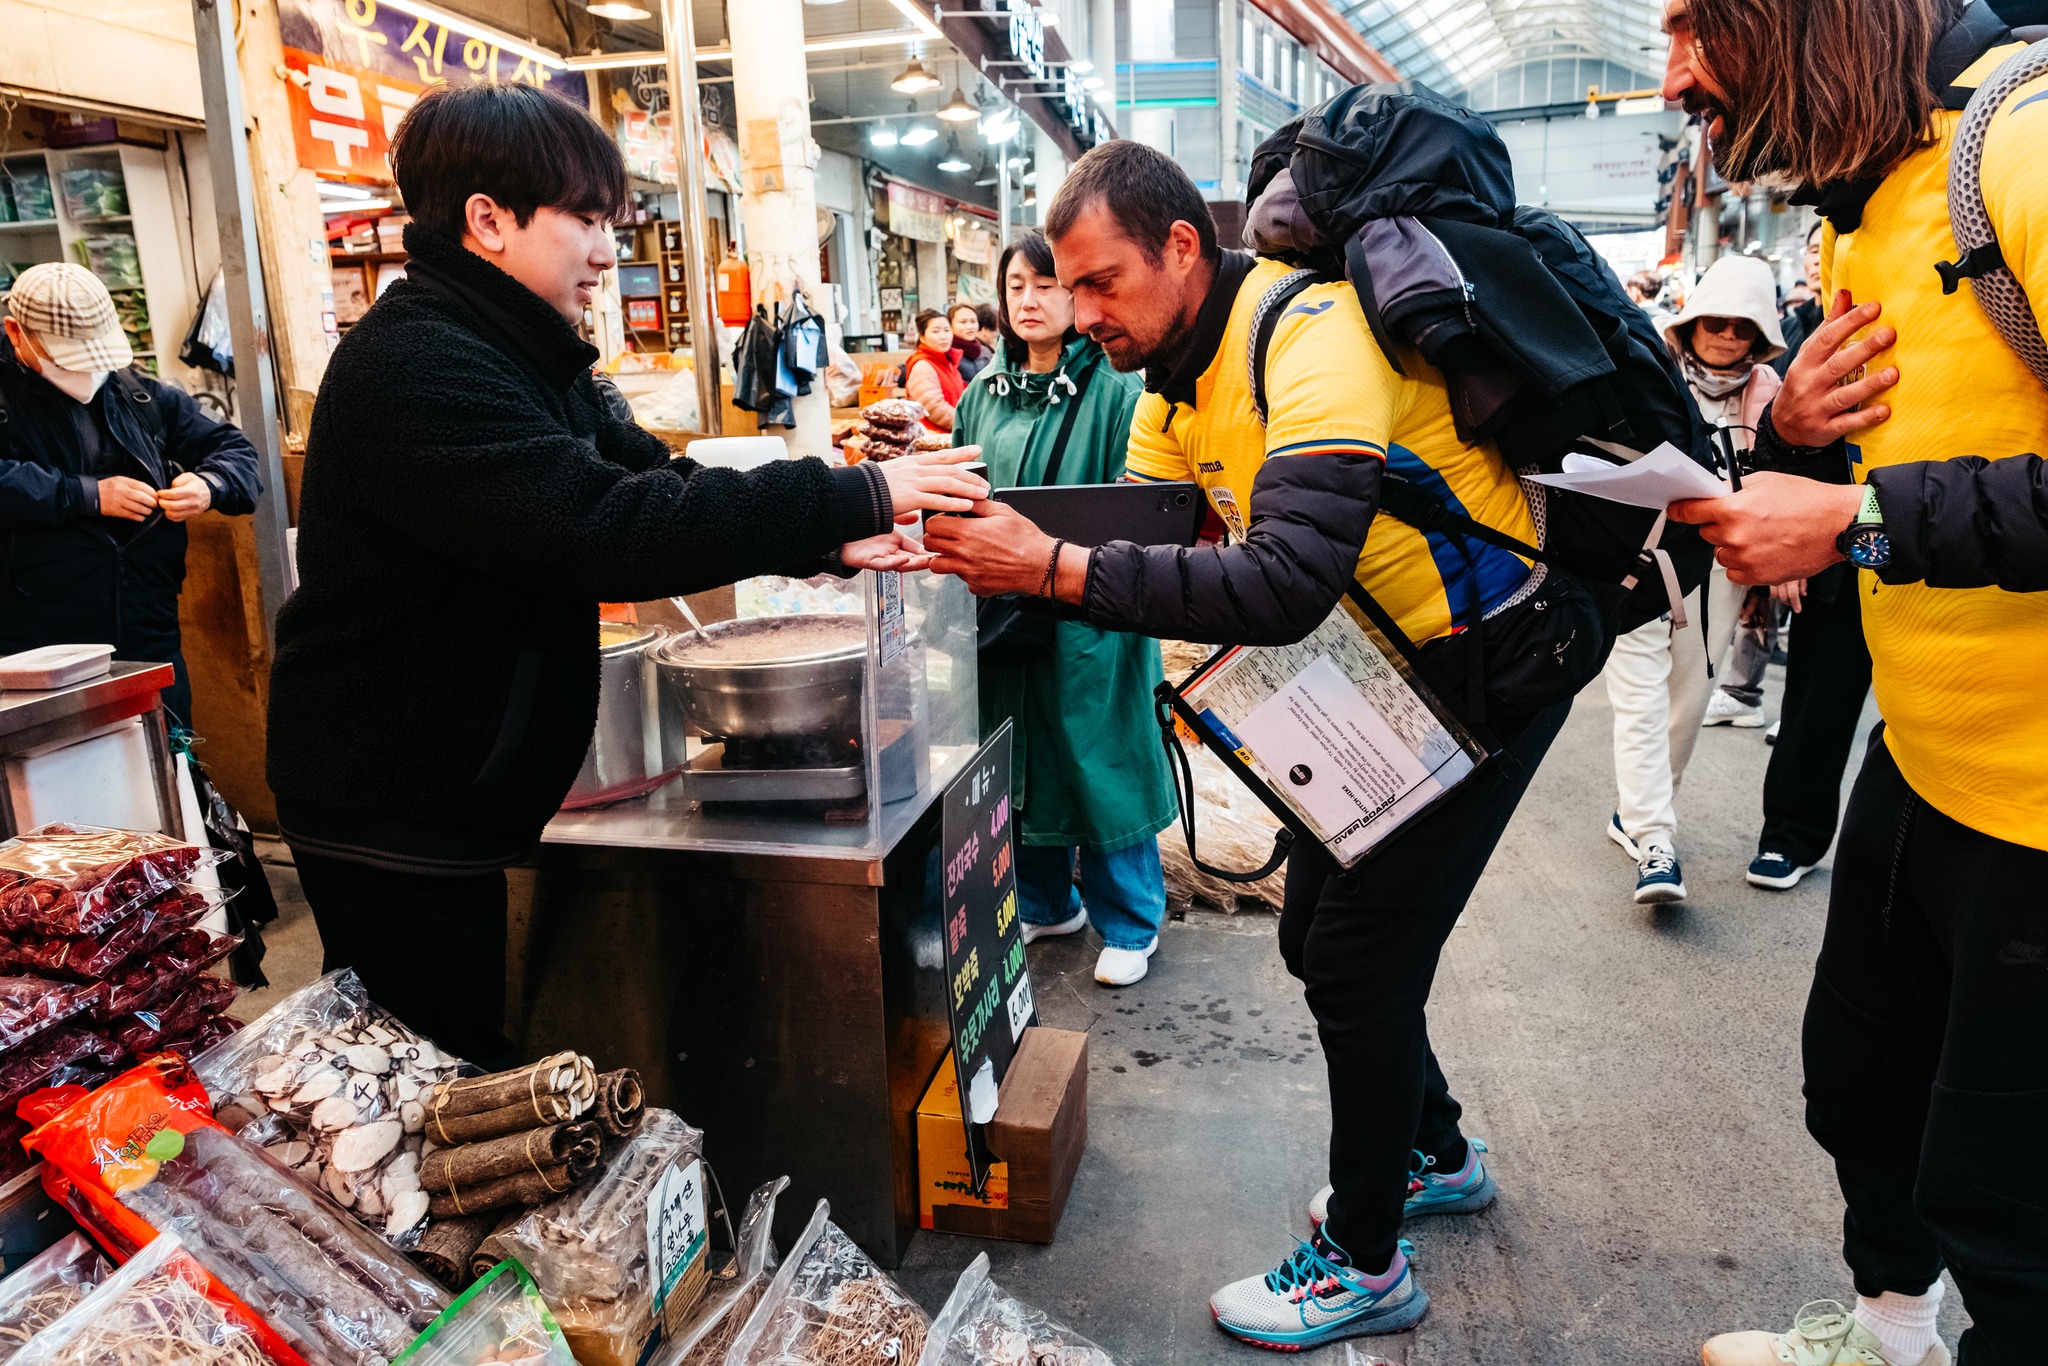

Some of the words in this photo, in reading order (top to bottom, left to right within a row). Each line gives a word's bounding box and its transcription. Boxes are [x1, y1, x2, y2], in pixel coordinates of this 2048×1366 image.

[1297, 685, 1307, 695] point
[1312, 702, 1320, 711] from
[1304, 713, 1315, 725] money
[1347, 720, 1355, 729] free?
[1309, 730, 1319, 741] called
[1330, 722, 1343, 736] Koreans
[1319, 741, 1332, 755] TV-show
[1347, 741, 1360, 755] kindness
[1333, 756, 1343, 767] reality
[1386, 763, 1394, 772] could
[1349, 774, 1367, 793] participants
[1357, 773, 1366, 782] travel
[972, 770, 991, 806] 메뉴
[1368, 774, 1389, 797] transportation
[1341, 784, 1368, 813] HITCH-HIKE
[947, 831, 979, 899] 잔치국수
[990, 793, 1008, 838] 4,000
[992, 841, 1010, 888] 5,000
[953, 947, 979, 1011] 호박죽
[997, 889, 1016, 938] 5,000
[960, 973, 1000, 1065] 우뭇가사리
[1003, 937, 1023, 985] 4,000
[91, 1113, 172, 1176] 자연담은
